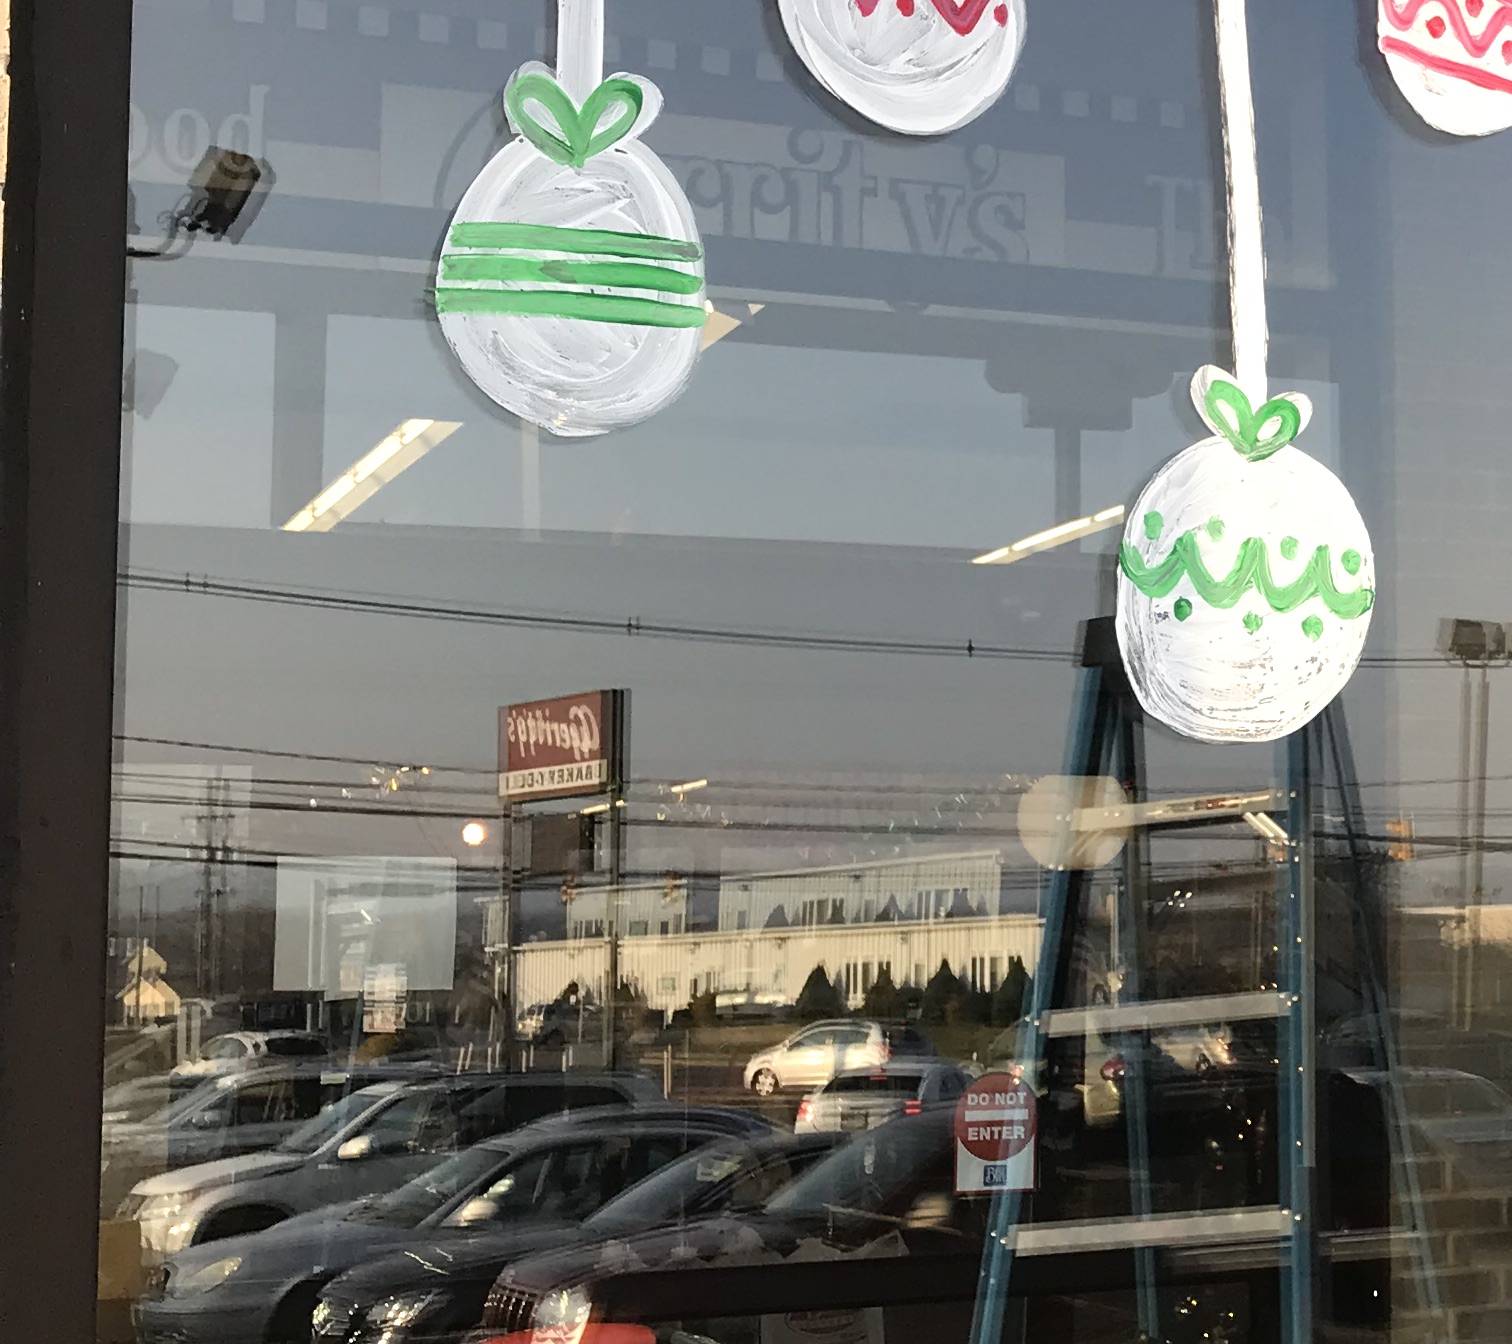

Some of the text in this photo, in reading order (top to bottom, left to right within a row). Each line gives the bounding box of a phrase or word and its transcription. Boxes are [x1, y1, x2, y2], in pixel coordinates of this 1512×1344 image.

[967, 1091, 1027, 1106] DO NOT
[967, 1125, 1026, 1142] ENTER
